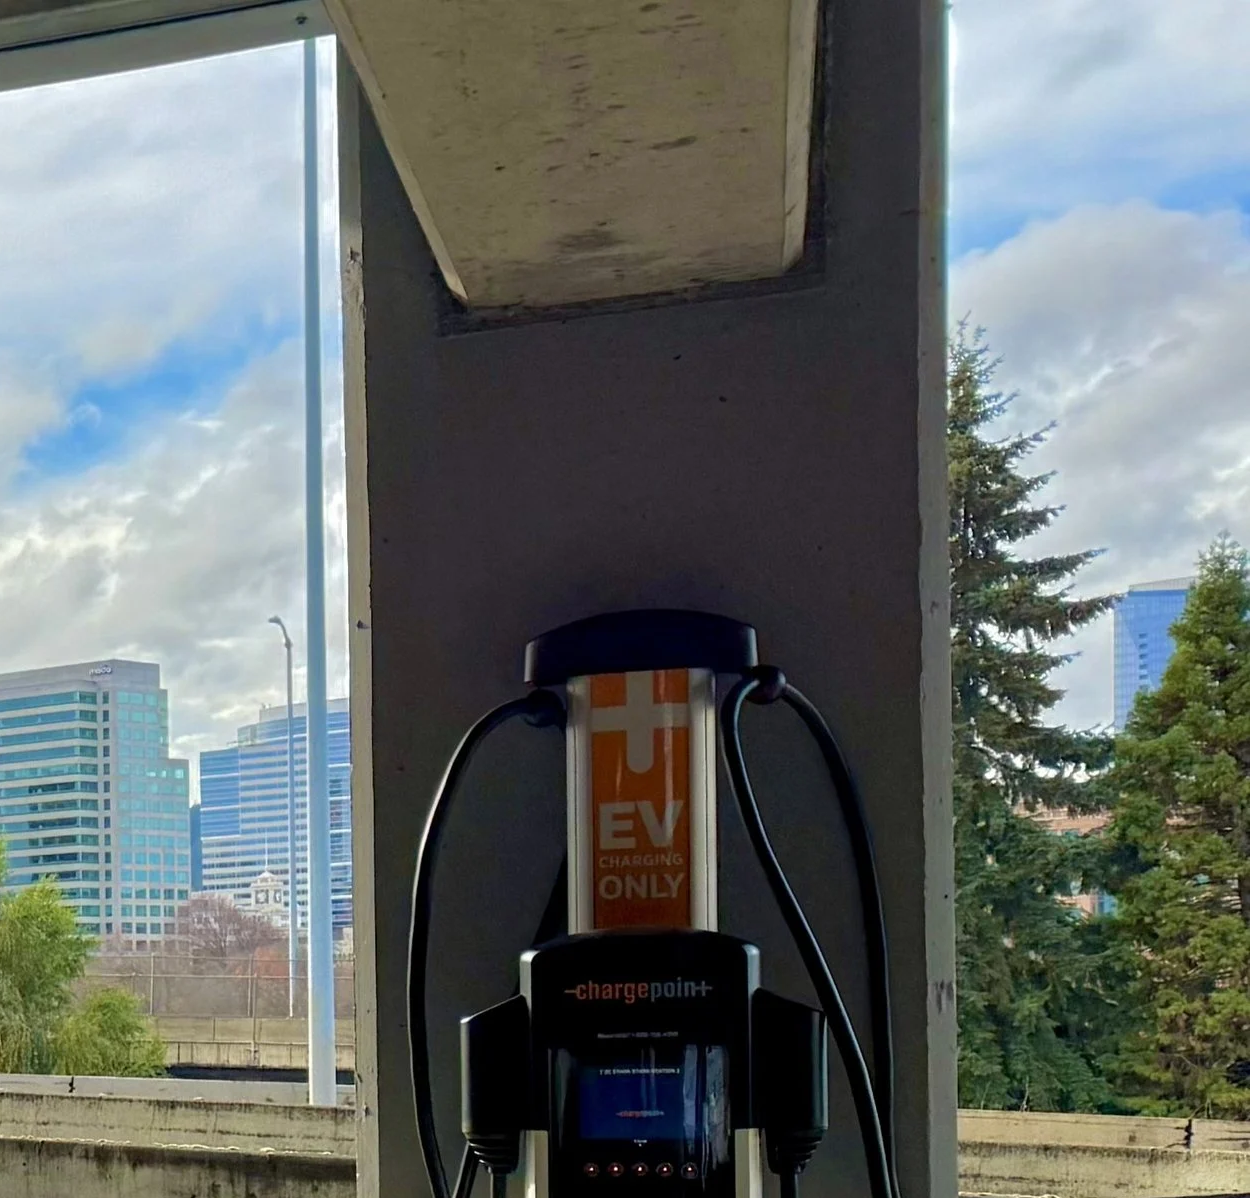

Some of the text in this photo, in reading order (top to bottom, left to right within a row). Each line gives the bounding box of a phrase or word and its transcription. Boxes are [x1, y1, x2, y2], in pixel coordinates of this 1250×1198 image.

[599, 800, 683, 850] EV
[599, 852, 683, 868] CHARGING
[600, 872, 684, 900] ONLY
